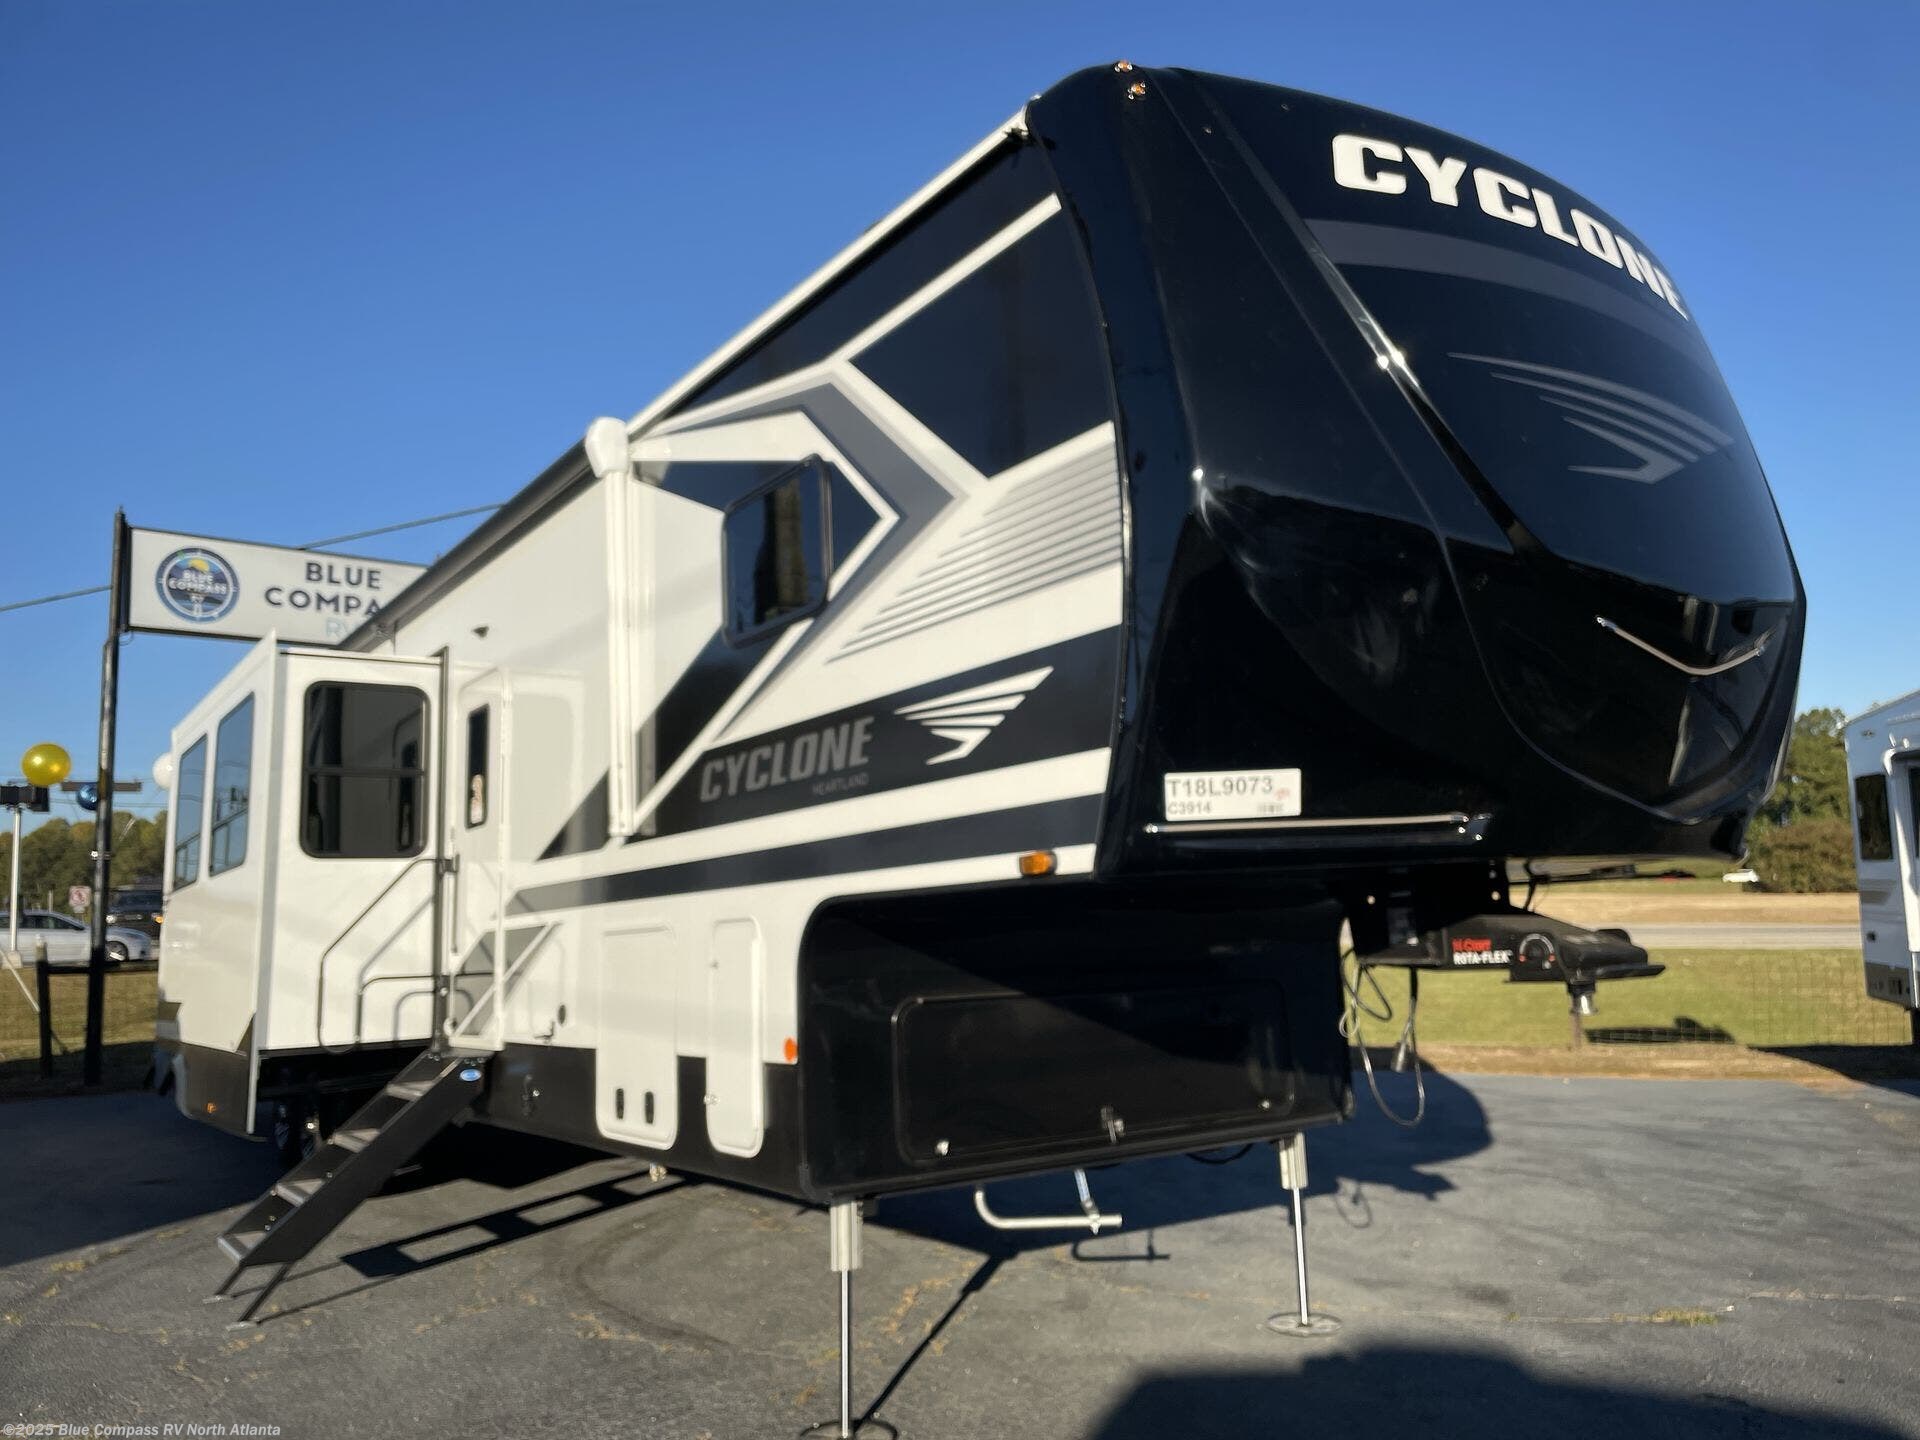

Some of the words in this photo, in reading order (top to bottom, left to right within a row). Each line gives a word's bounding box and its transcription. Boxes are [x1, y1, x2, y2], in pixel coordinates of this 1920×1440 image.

[1332, 133, 1690, 322] CYCLONE
[168, 577, 227, 595] COMPASS
[183, 569, 214, 584] BLUE
[305, 561, 381, 590] BLUE
[701, 716, 875, 803] CYCLONE
[1167, 776, 1274, 798] T18L9073
